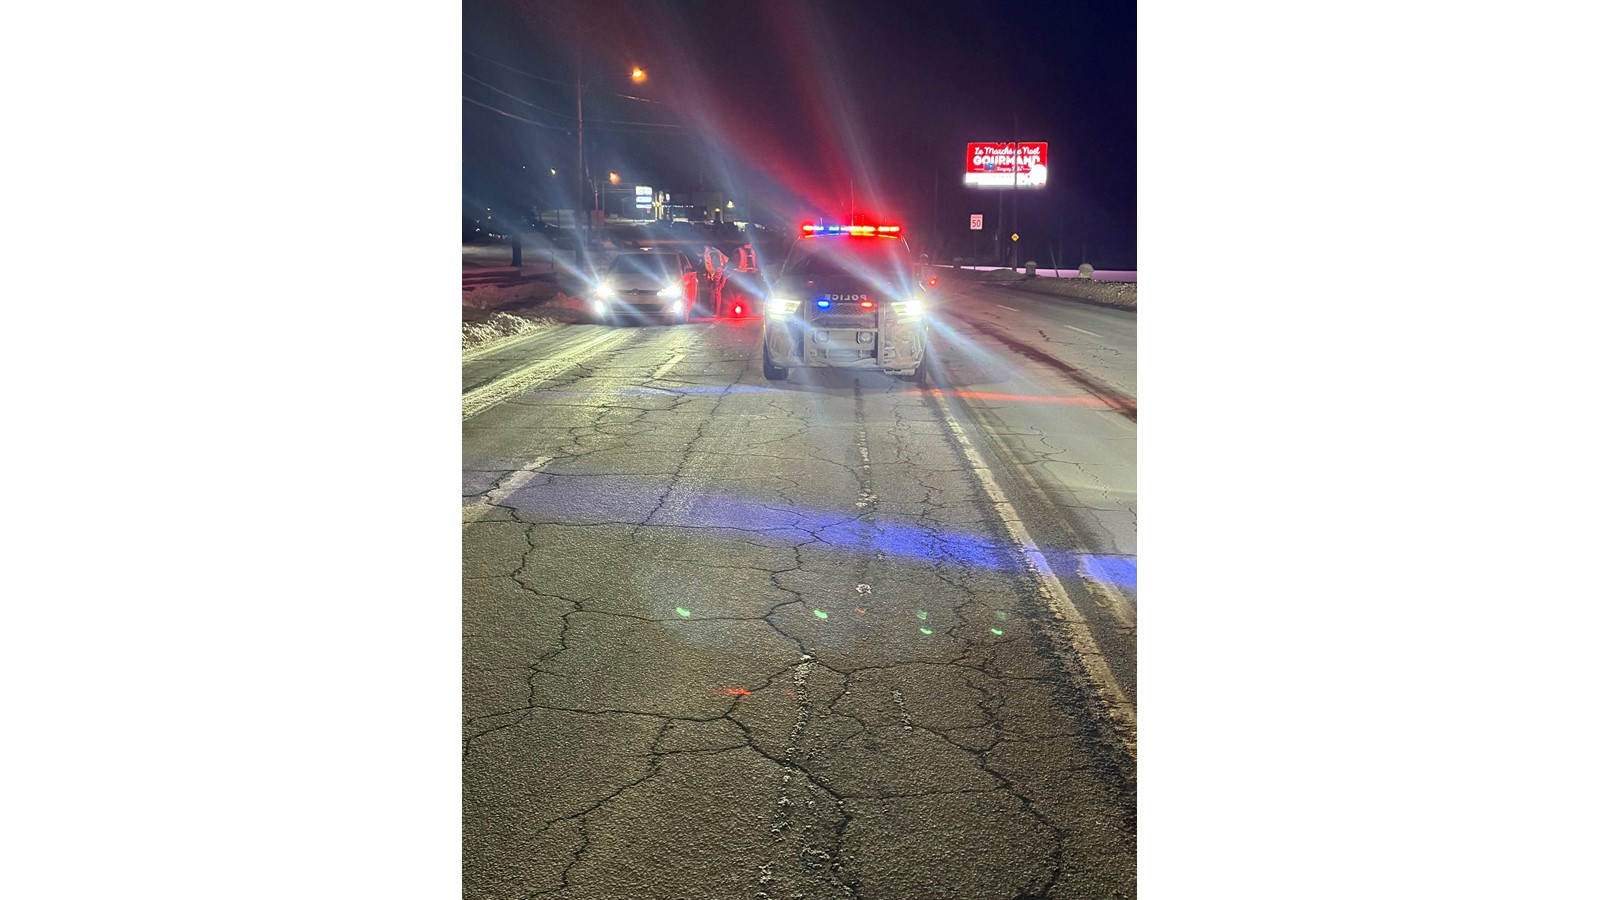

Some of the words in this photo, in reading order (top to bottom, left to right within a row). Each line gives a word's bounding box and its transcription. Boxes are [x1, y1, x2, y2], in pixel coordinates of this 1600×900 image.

[974, 146, 984, 155] Le
[973, 155, 1041, 166] GOURMAND
[972, 219, 982, 228] 50
